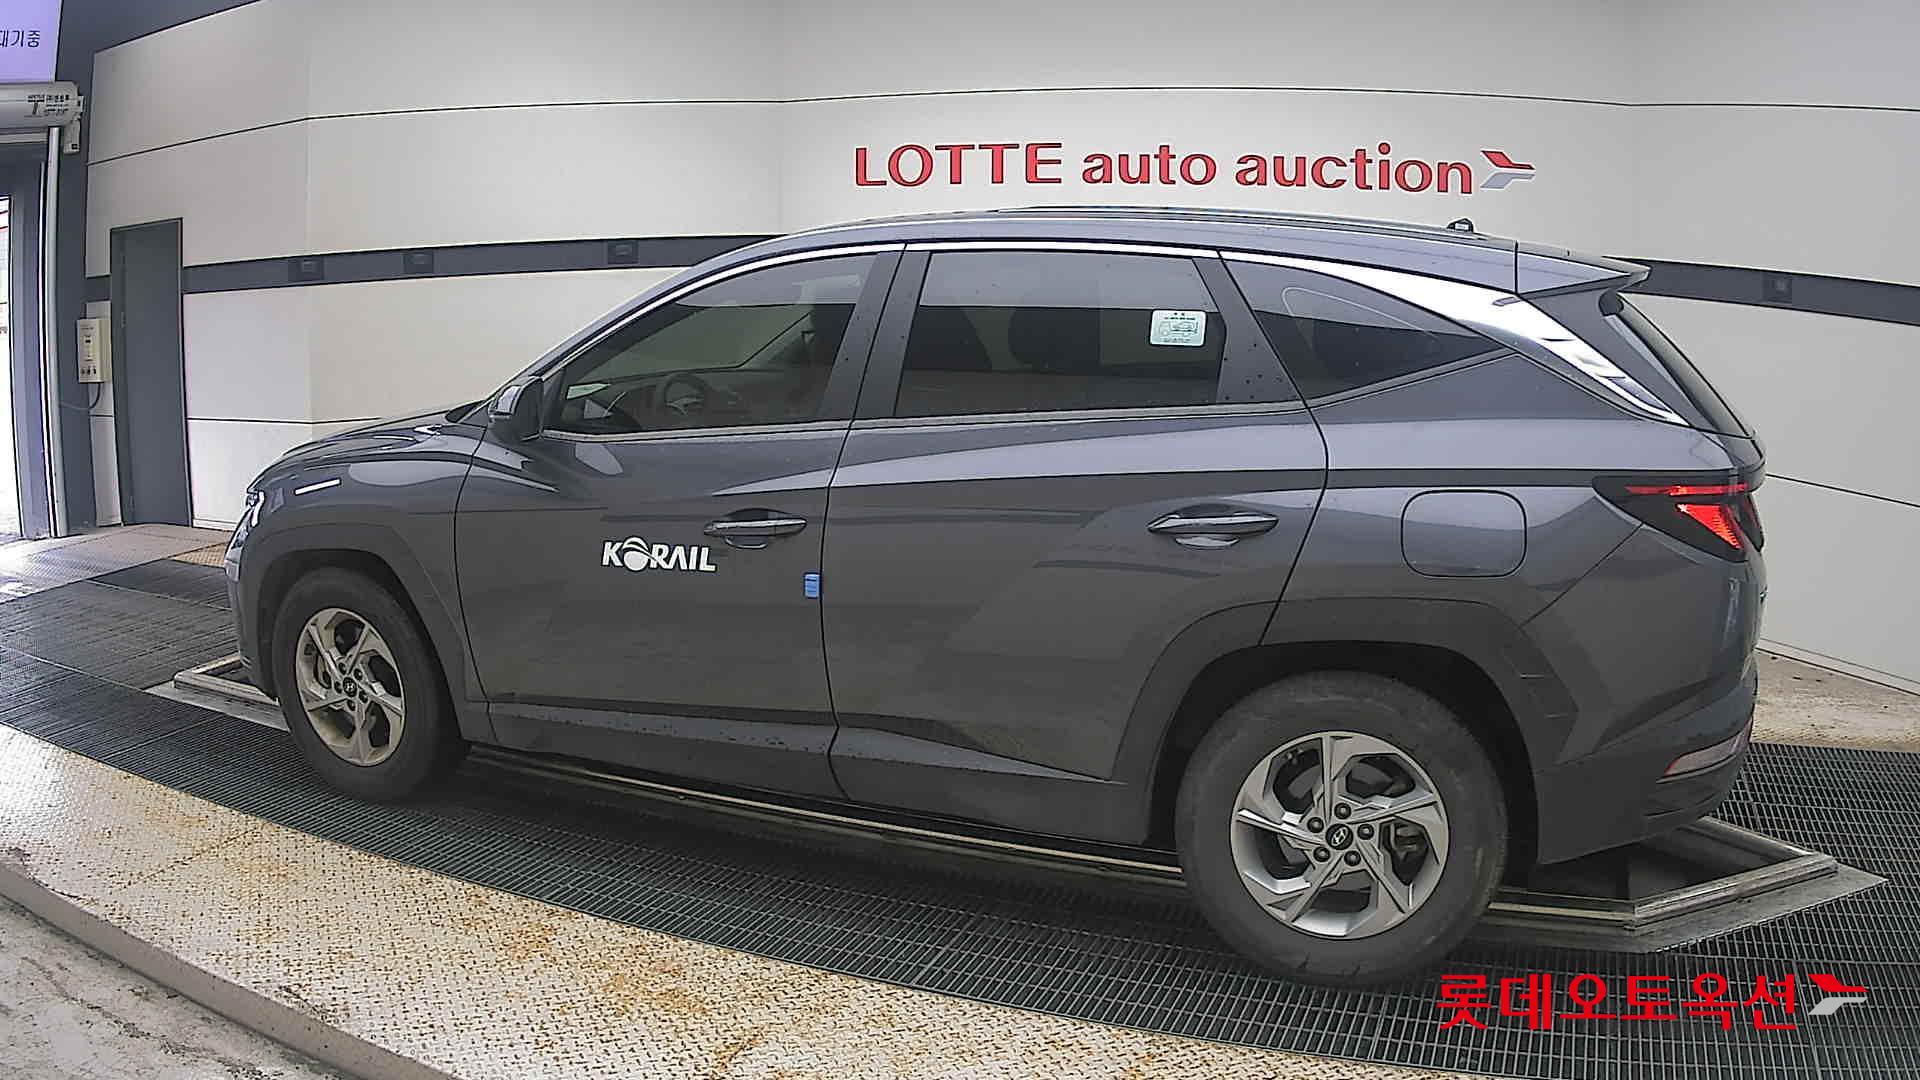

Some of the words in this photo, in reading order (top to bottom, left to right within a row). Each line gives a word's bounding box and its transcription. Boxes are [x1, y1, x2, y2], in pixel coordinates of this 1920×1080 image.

[855, 142, 1062, 187] LOTTE
[1081, 144, 1217, 186] auto
[1235, 142, 1473, 194] auction
[602, 536, 716, 572] KORAIL
